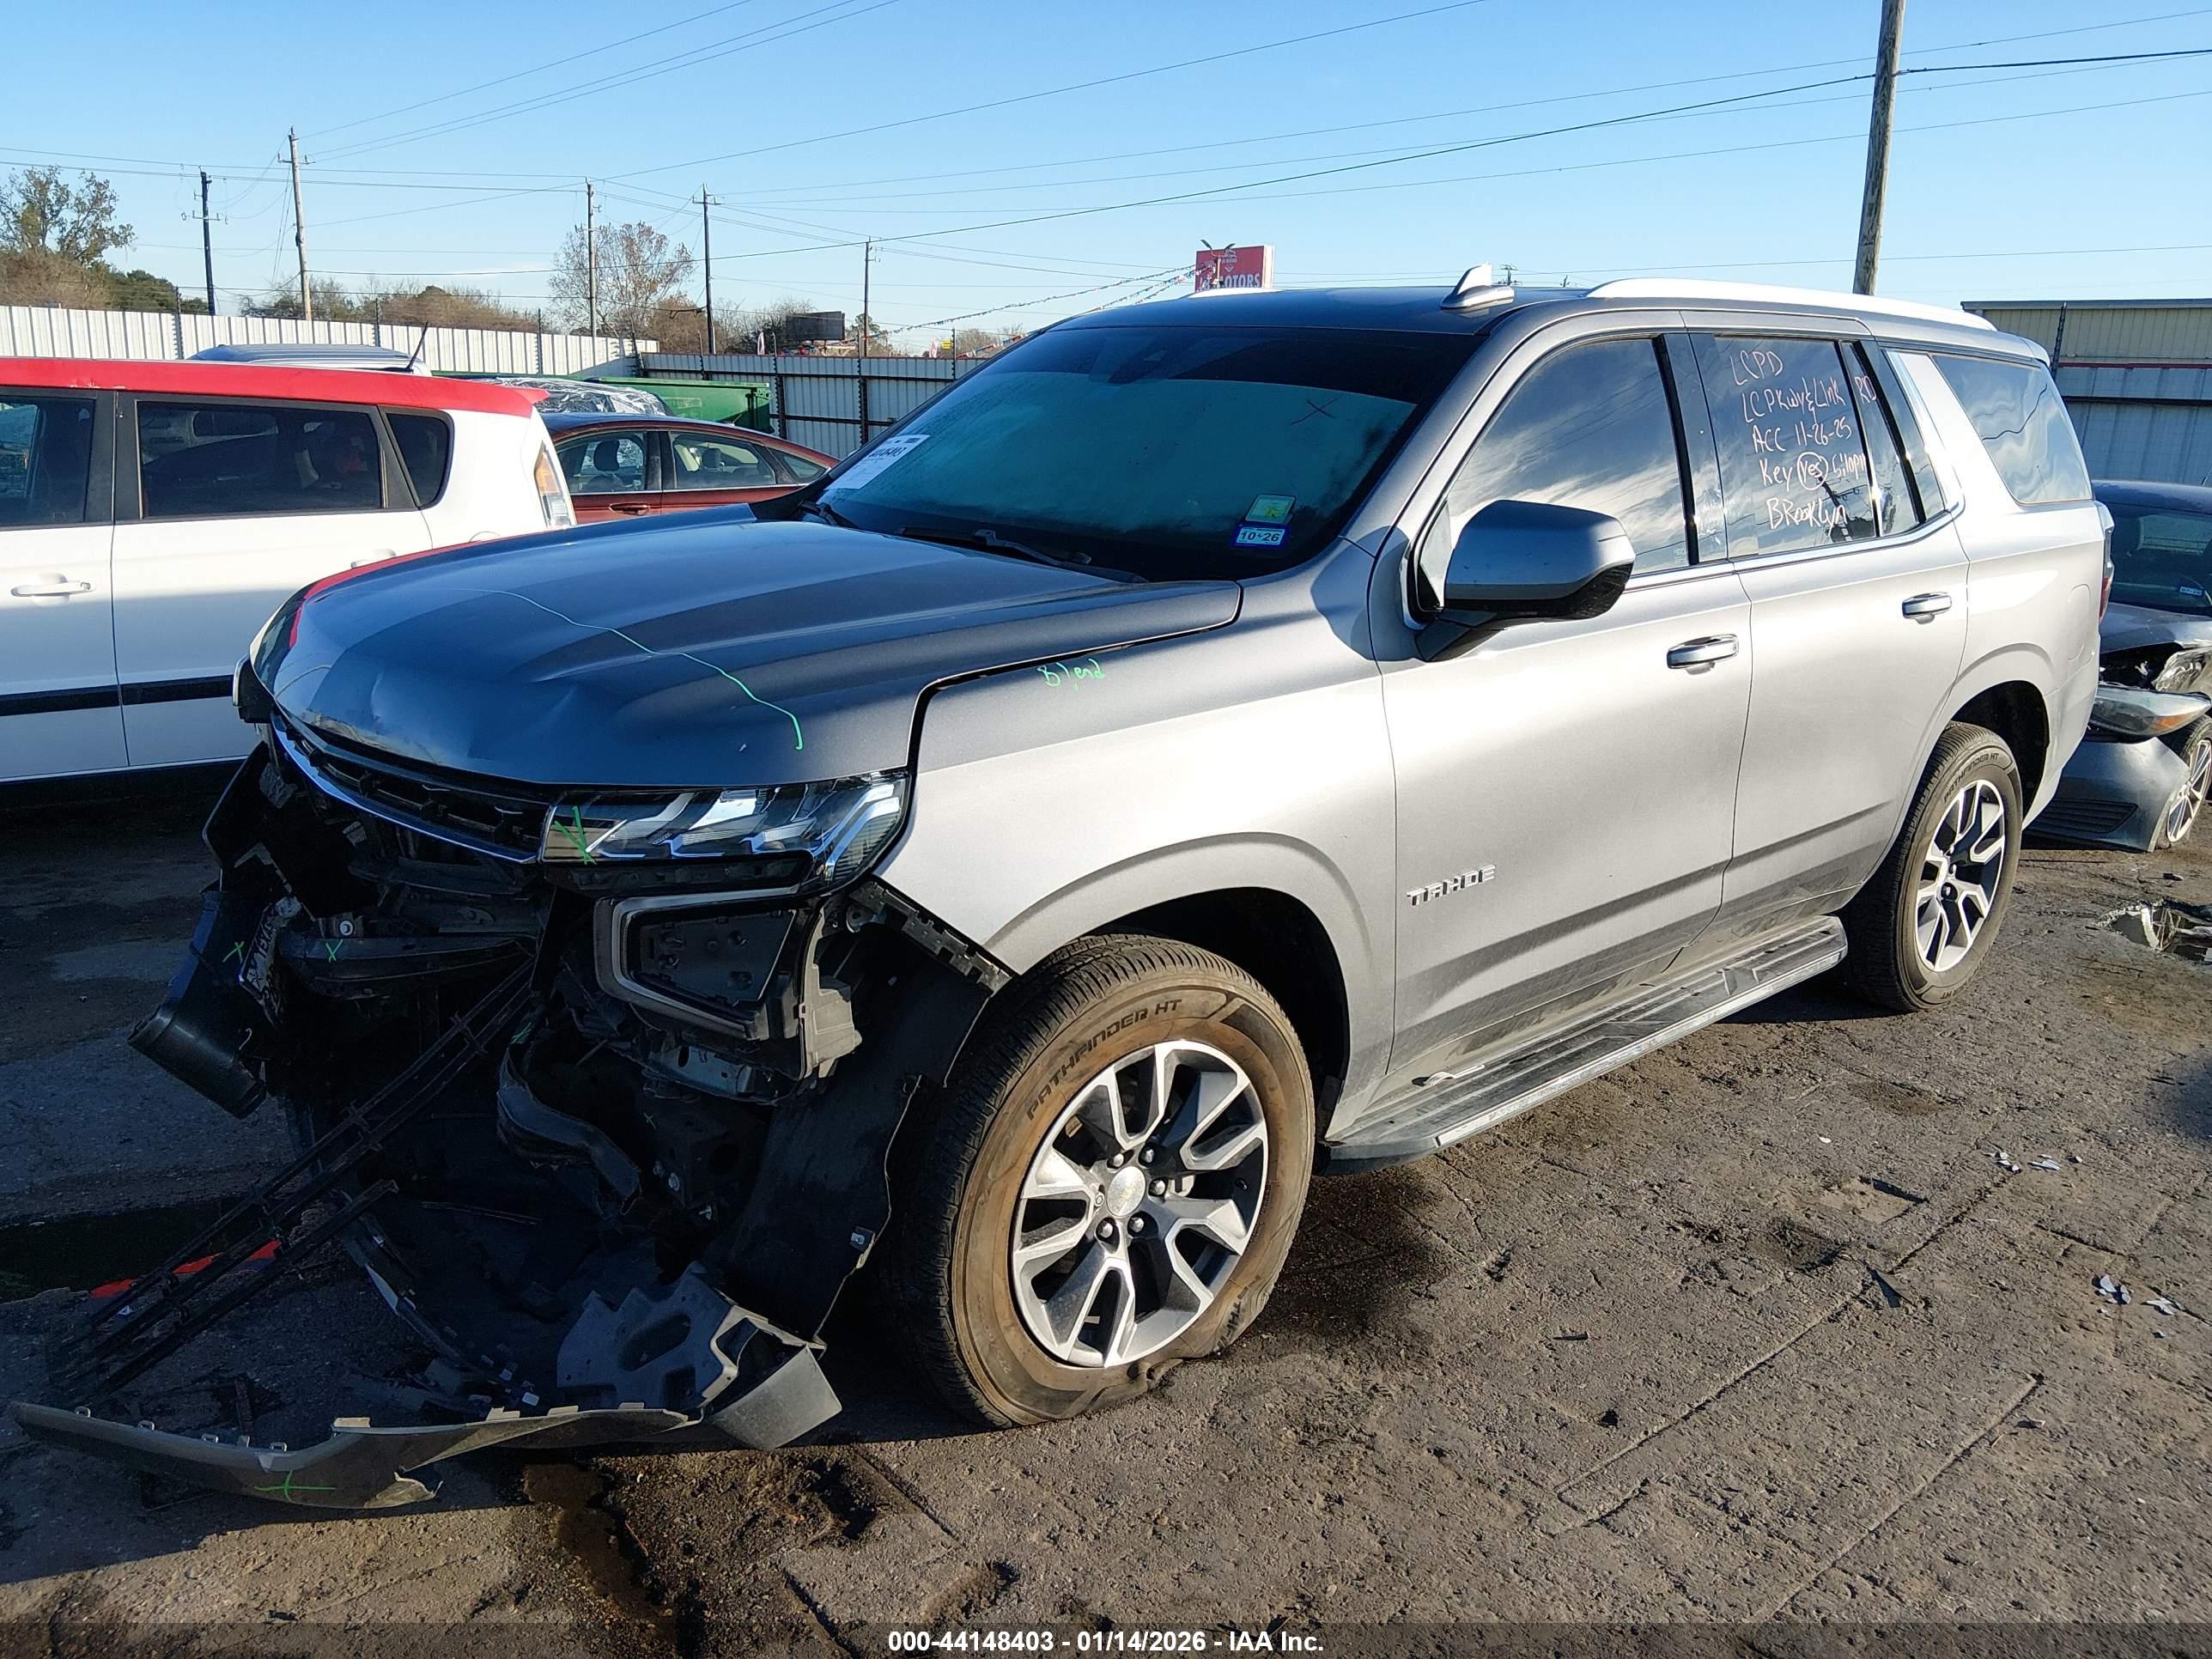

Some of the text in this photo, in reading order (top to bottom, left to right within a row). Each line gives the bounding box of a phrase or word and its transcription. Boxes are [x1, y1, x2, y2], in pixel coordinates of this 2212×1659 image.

[1730, 349, 1784, 386] LCPD
[1854, 375, 1877, 404] RD
[1752, 416, 1852, 453] ACC 11-26-25
[1759, 458, 1793, 492] Key
[1407, 864, 1496, 907] TAHOE
[1027, 999, 1182, 1121] PATHFINDER HT
